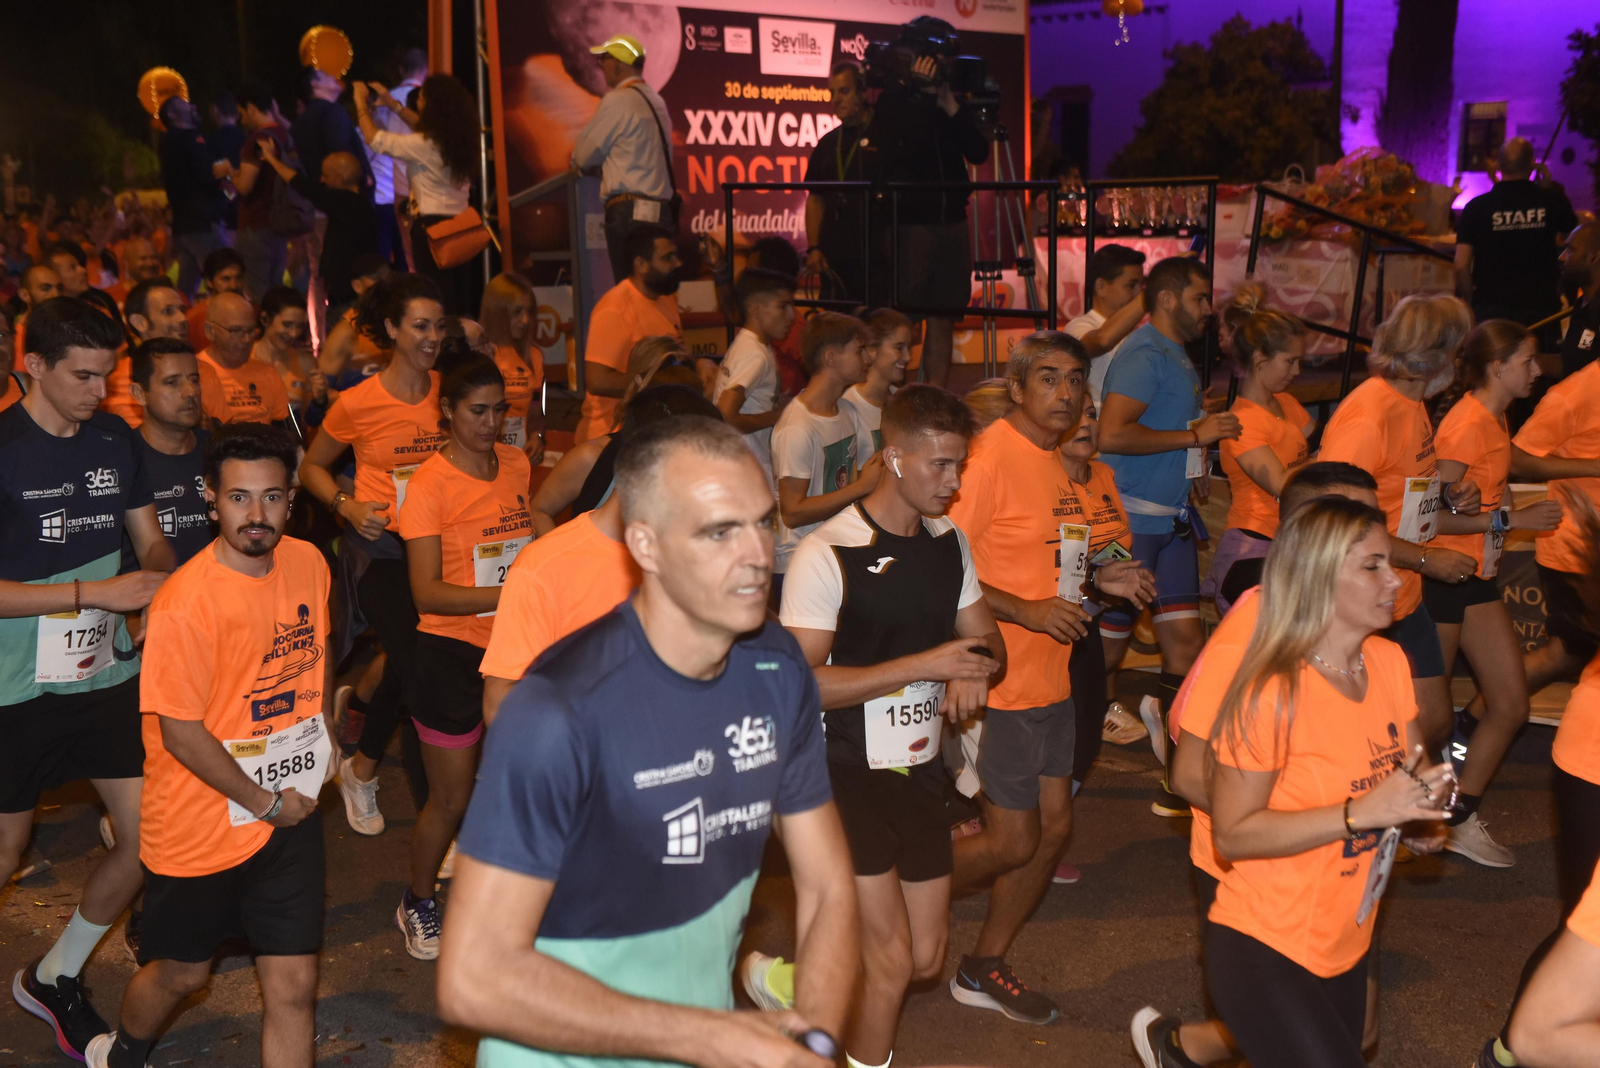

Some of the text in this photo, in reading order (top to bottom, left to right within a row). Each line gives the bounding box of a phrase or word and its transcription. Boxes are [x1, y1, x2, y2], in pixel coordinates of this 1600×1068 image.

[725, 81, 832, 105] 30 de septiembre
[684, 109, 776, 147] XXXIV
[691, 208, 720, 233] del
[1492, 208, 1546, 225] STAFF
[692, 343, 717, 355] IMD
[394, 445, 431, 454] SEVILLA
[88, 487, 120, 497] TRAINING
[67, 514, 114, 527] CRISTALERIA
[94, 522, 114, 530] REYES
[482, 523, 519, 537] SEVILLA
[64, 620, 108, 649] 17254
[886, 696, 939, 727] 15590
[724, 715, 769, 758] 365
[254, 751, 315, 786] 15588
[733, 748, 777, 773] TRAINING
[705, 799, 771, 833] CRISTALERIA
